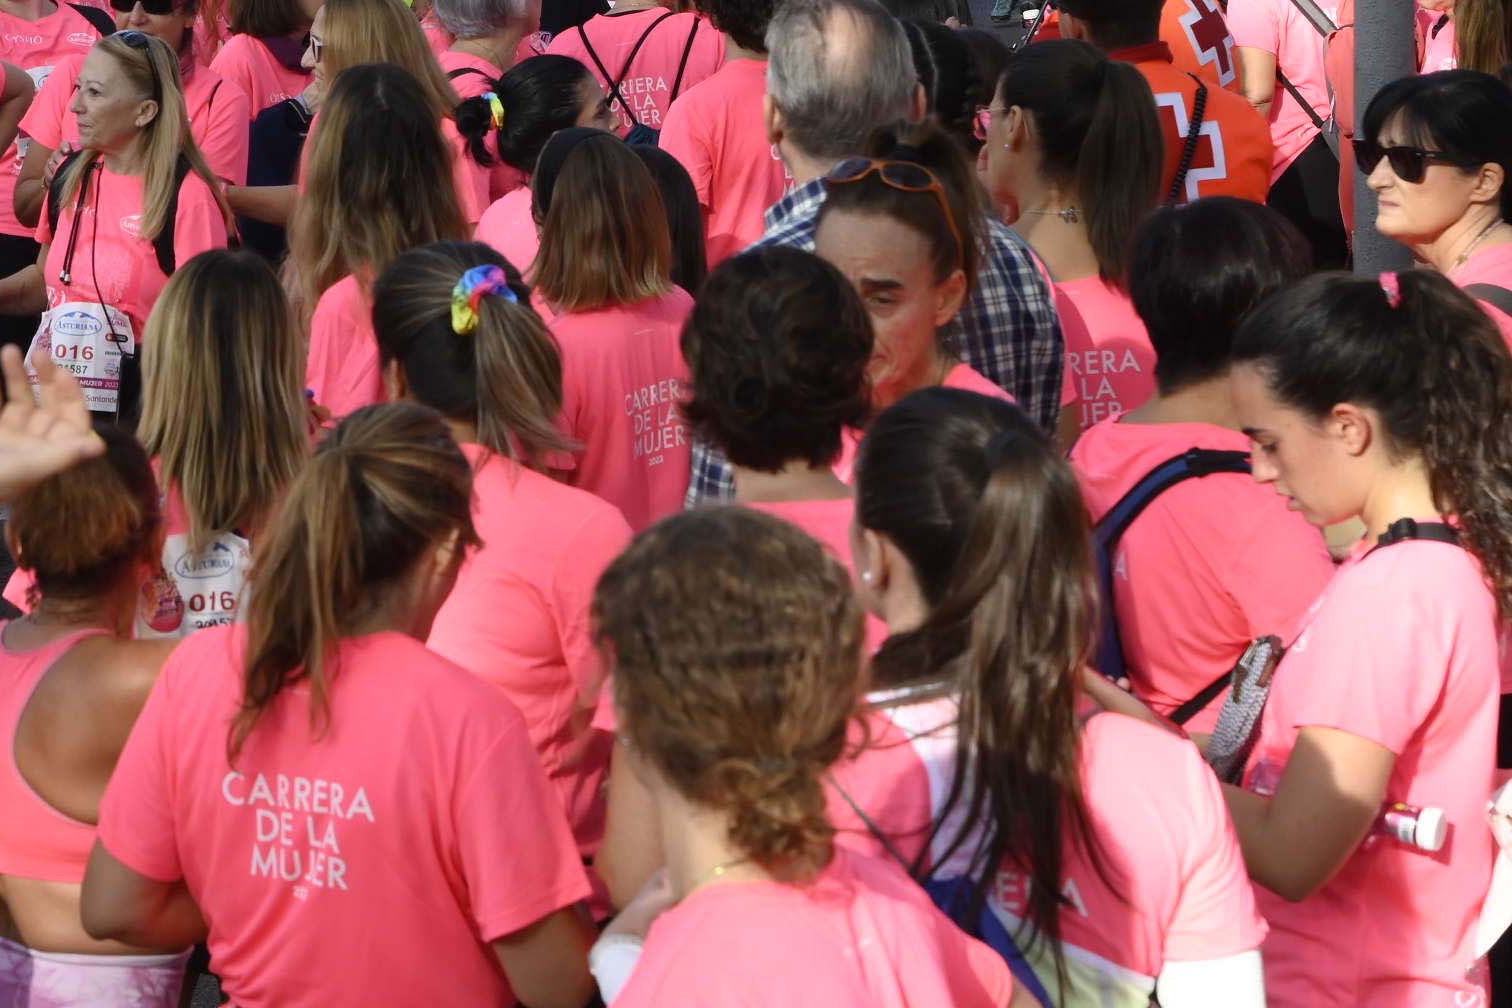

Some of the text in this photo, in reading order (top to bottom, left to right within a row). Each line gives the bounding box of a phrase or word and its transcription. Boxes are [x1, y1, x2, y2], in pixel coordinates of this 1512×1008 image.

[635, 94, 657, 111] LA
[55, 345, 95, 360] 016
[1081, 376, 1117, 401] LA
[634, 401, 680, 435] DE LA
[633, 424, 686, 460] MUJER
[189, 591, 236, 612] 016
[222, 771, 376, 823] CARRERA
[256, 808, 341, 855] DE LA
[250, 843, 349, 891] MUJER
